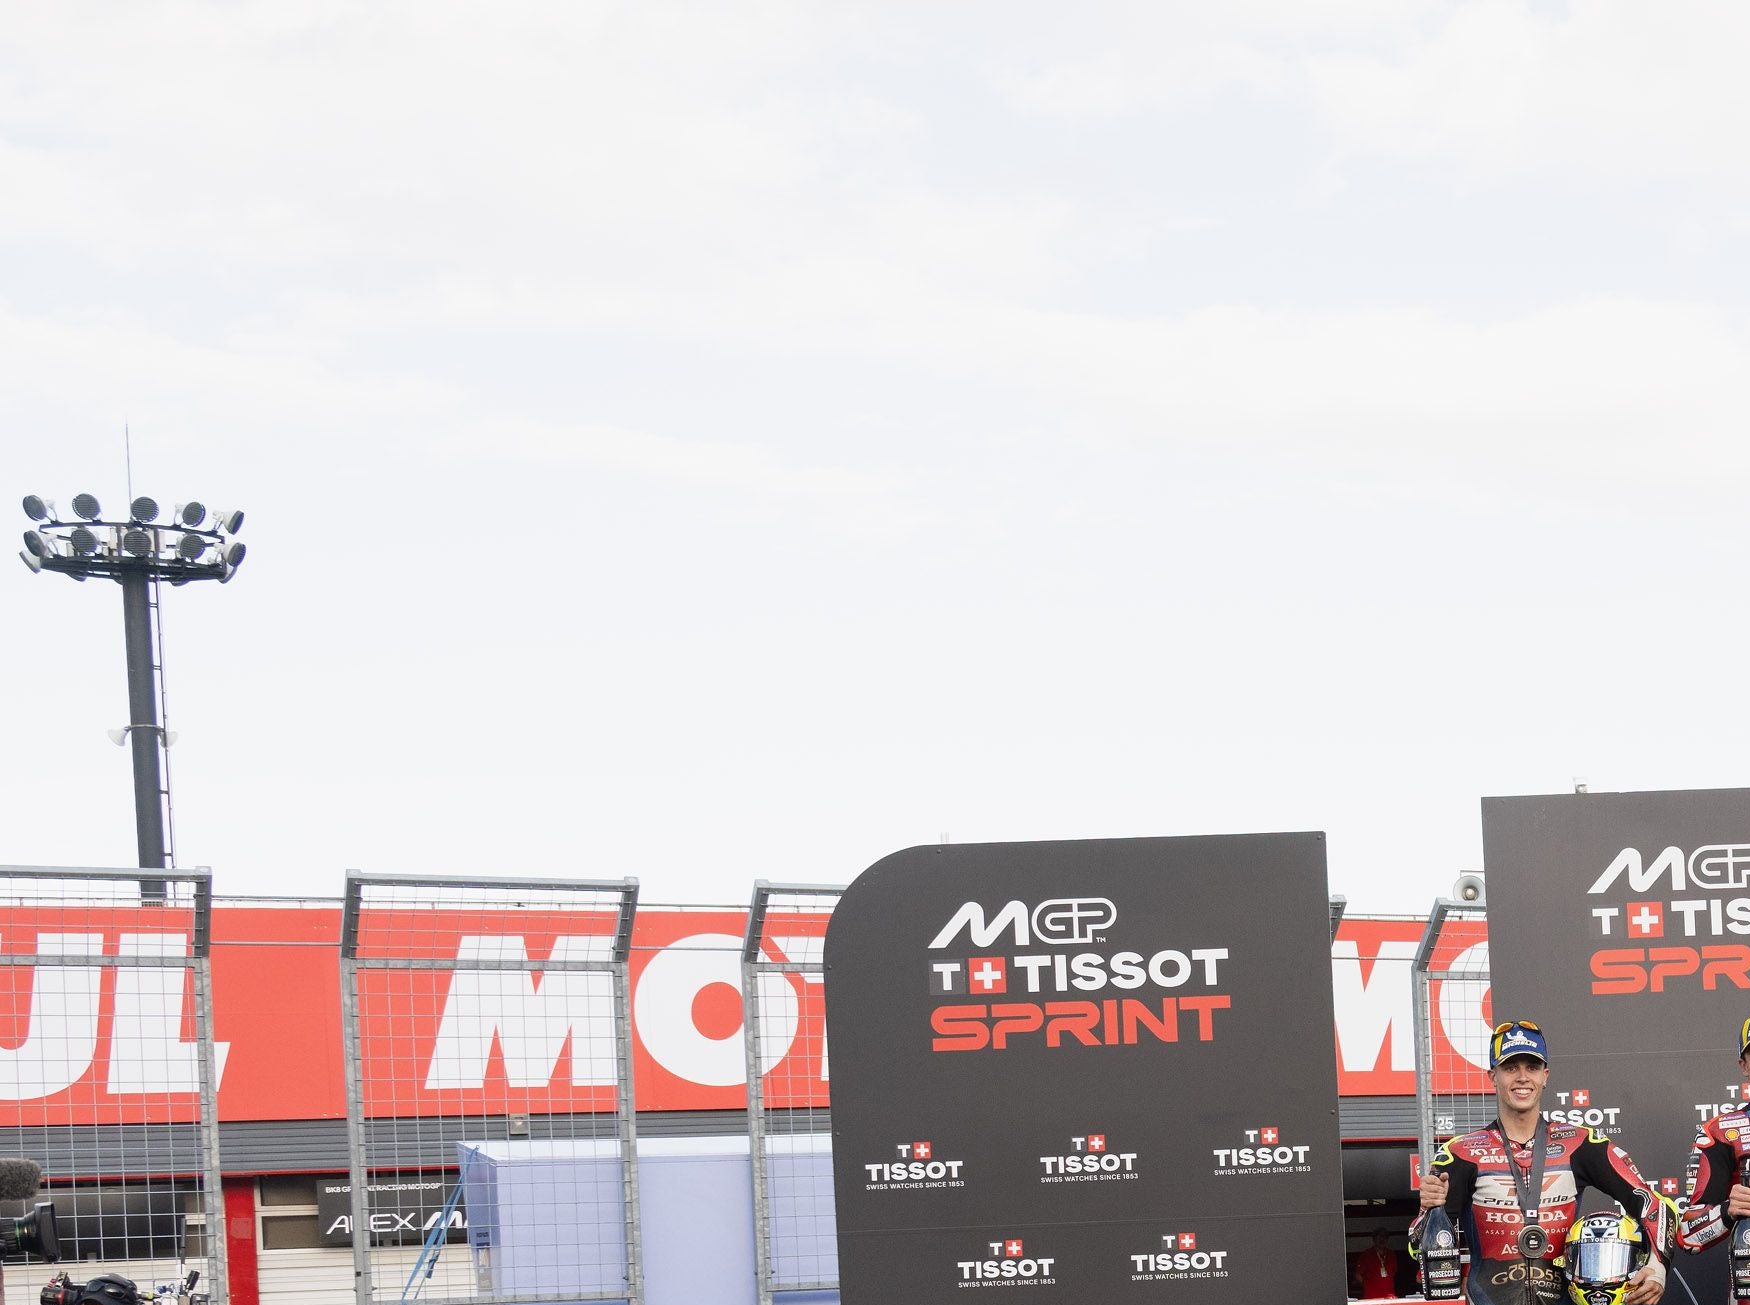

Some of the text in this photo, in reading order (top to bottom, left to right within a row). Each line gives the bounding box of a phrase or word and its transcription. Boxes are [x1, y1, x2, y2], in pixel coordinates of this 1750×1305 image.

[1013, 948, 1229, 993] TISSOT
[930, 995, 1231, 1052] SPRINT
[1437, 1118, 1454, 1130] 25
[1040, 1153, 1138, 1174] TISSOT
[1213, 1146, 1310, 1167] TISSOT
[865, 1160, 964, 1182] TISSOT
[1064, 1174, 1098, 1182] WATCHES
[1099, 1173, 1121, 1181] SINCE
[1122, 1172, 1139, 1180] 1853
[1237, 1167, 1271, 1175] WATCHES
[866, 1183, 888, 1191] SWISS
[948, 1180, 965, 1188] 1853
[1485, 1210, 1567, 1224] HODA
[1695, 1228, 1716, 1244] Unipol
[1428, 1250, 1452, 1258] PROSECCO
[957, 1258, 1055, 1279] TISSOT
[1131, 1251, 1227, 1272] TISSOT
[1155, 1272, 1188, 1280] WATCHES
[1189, 1271, 1211, 1279] SINCE
[1429, 1270, 1453, 1278] PROSECCO
[958, 1280, 980, 1288] SWISS
[982, 1279, 1015, 1287] WATCHES
[1017, 1278, 1038, 1286] SINCE
